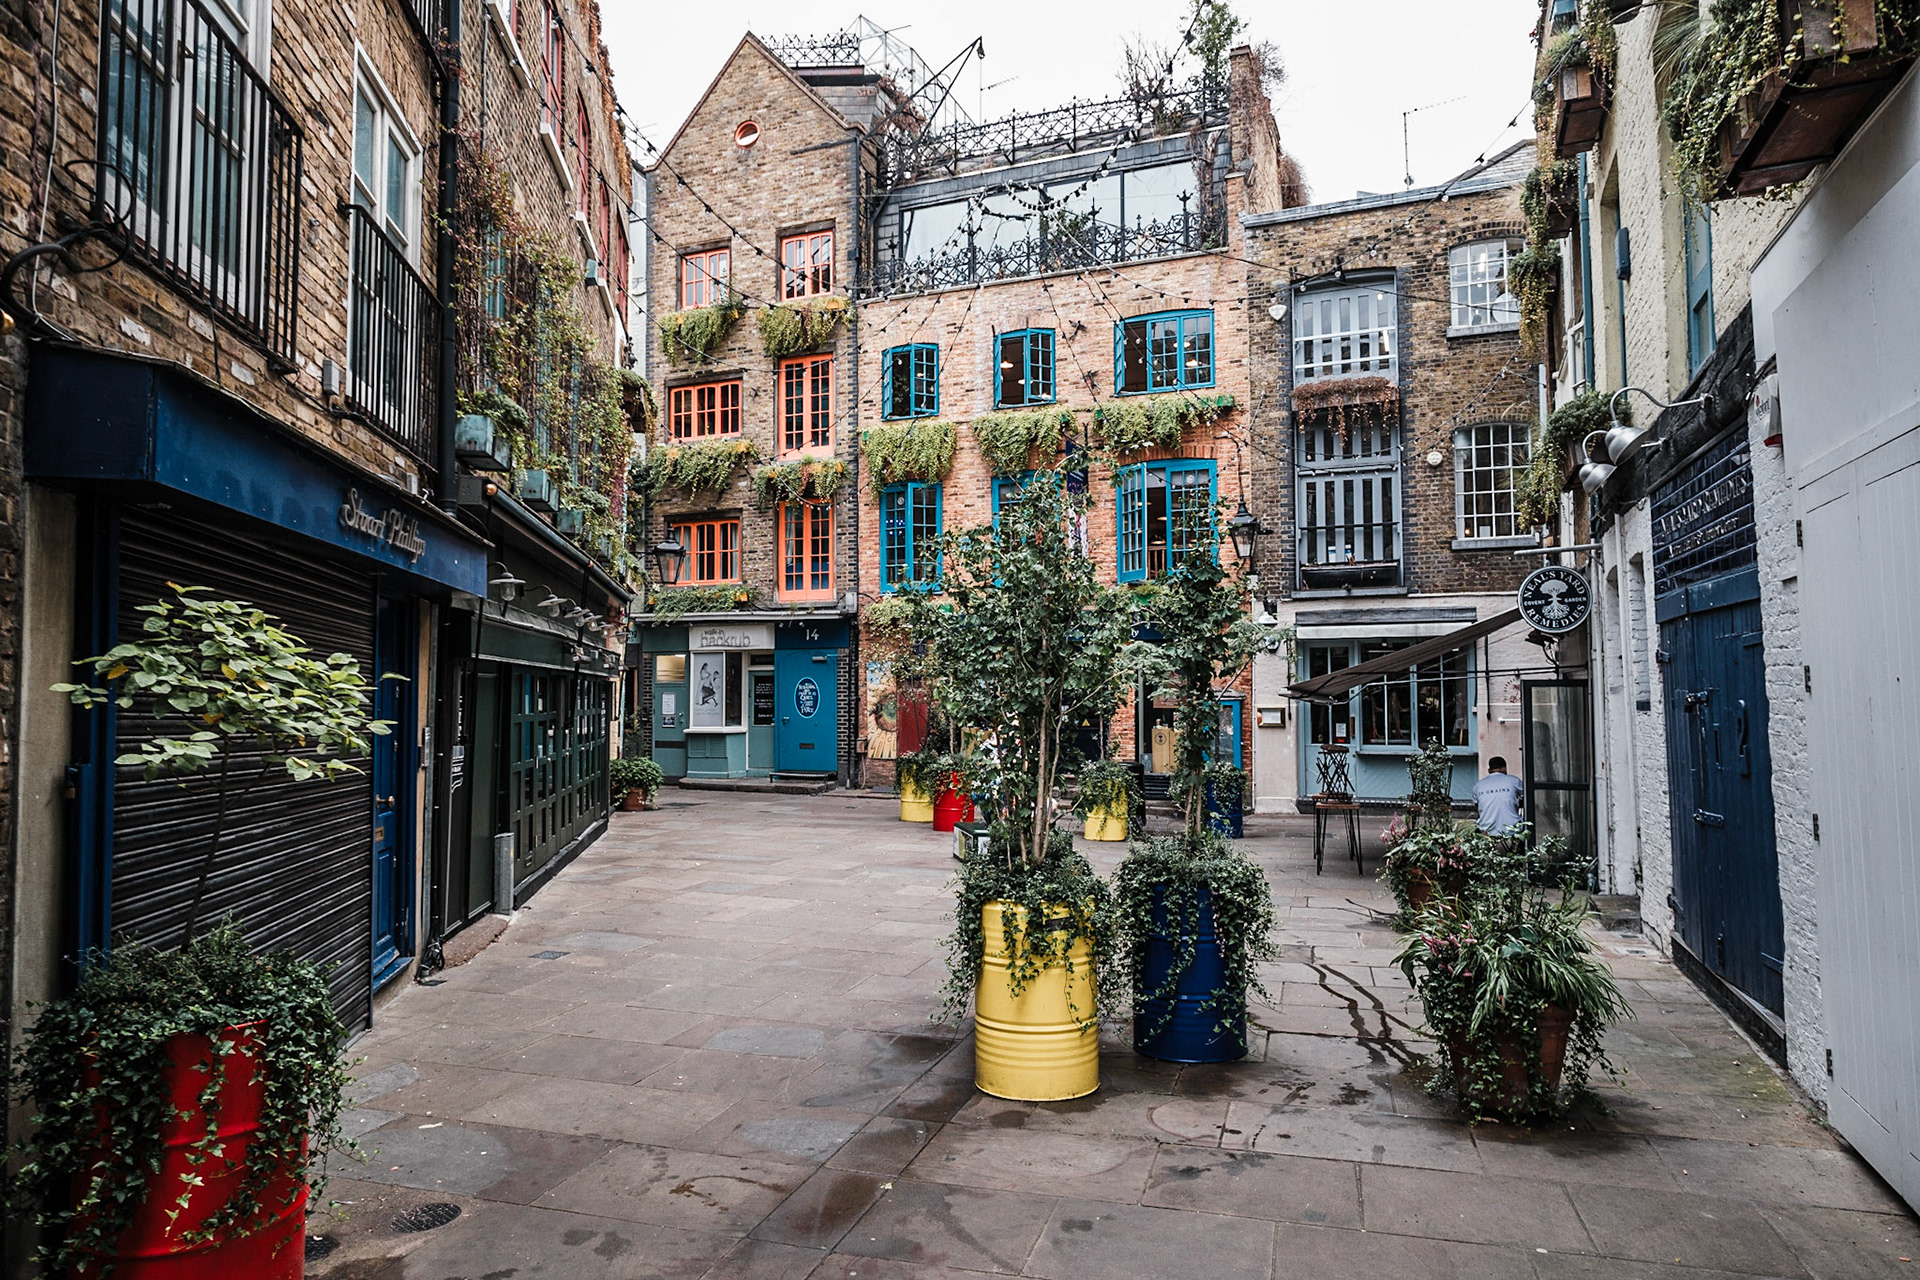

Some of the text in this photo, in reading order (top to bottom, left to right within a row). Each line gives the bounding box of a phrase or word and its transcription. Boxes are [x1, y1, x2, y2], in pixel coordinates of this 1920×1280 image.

[340, 487, 426, 565] Stuart Phillips
[1524, 570, 1586, 598] NEAL'S YARD
[1526, 604, 1586, 628] REMEDIES
[701, 632, 751, 647] backrub
[704, 628, 725, 636] walk-in
[806, 628, 820, 641] 14
